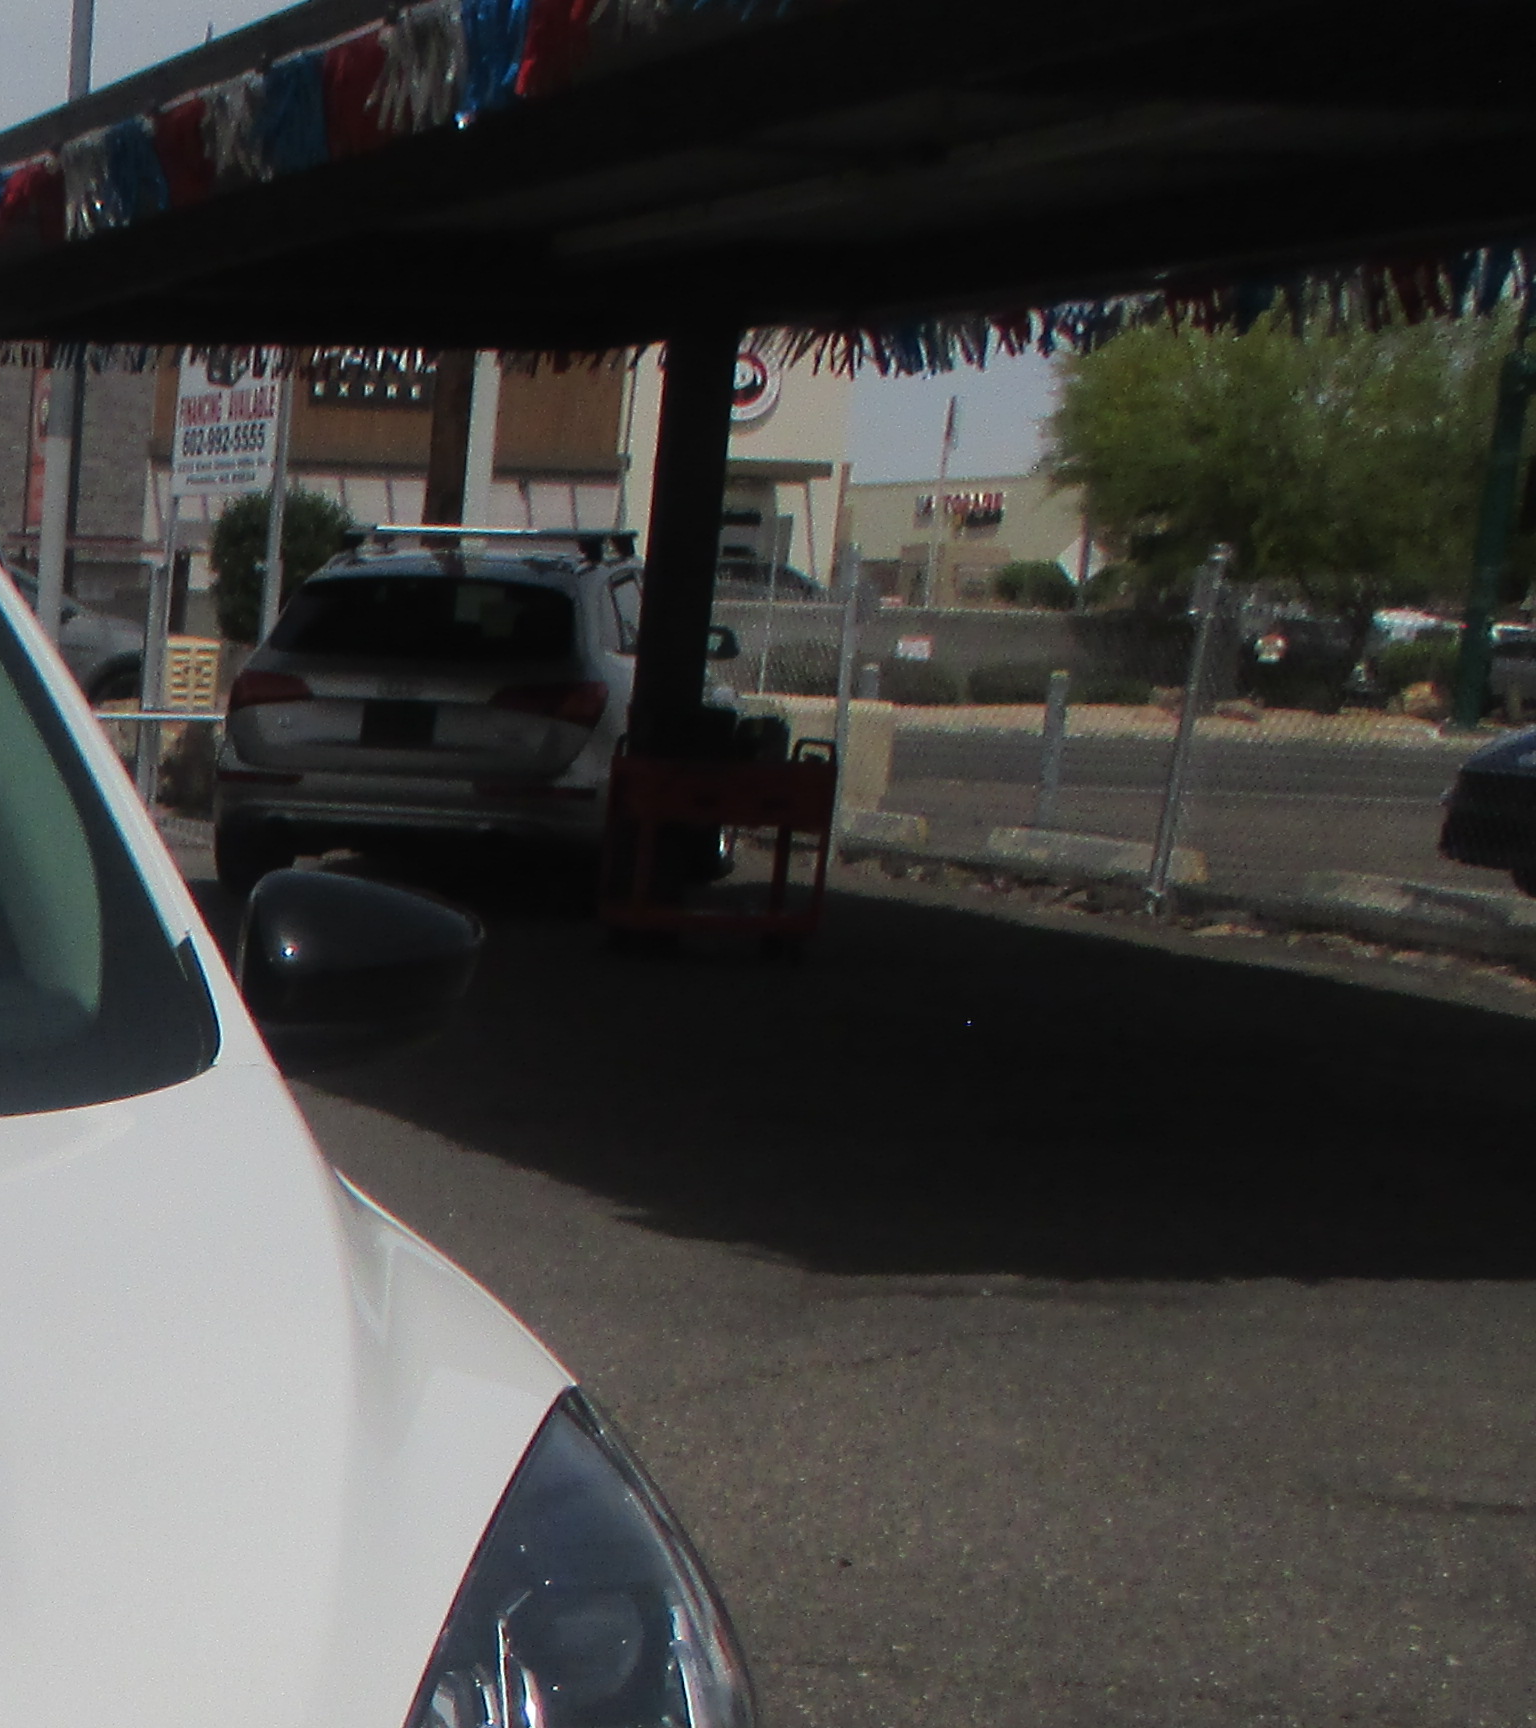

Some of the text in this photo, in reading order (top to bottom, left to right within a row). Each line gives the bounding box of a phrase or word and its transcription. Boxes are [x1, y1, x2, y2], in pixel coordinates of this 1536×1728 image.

[180, 384, 276, 427] FINANCING AVAILABLE
[314, 379, 423, 400] EXPRE
[182, 422, 266, 456] 602-992-5555
